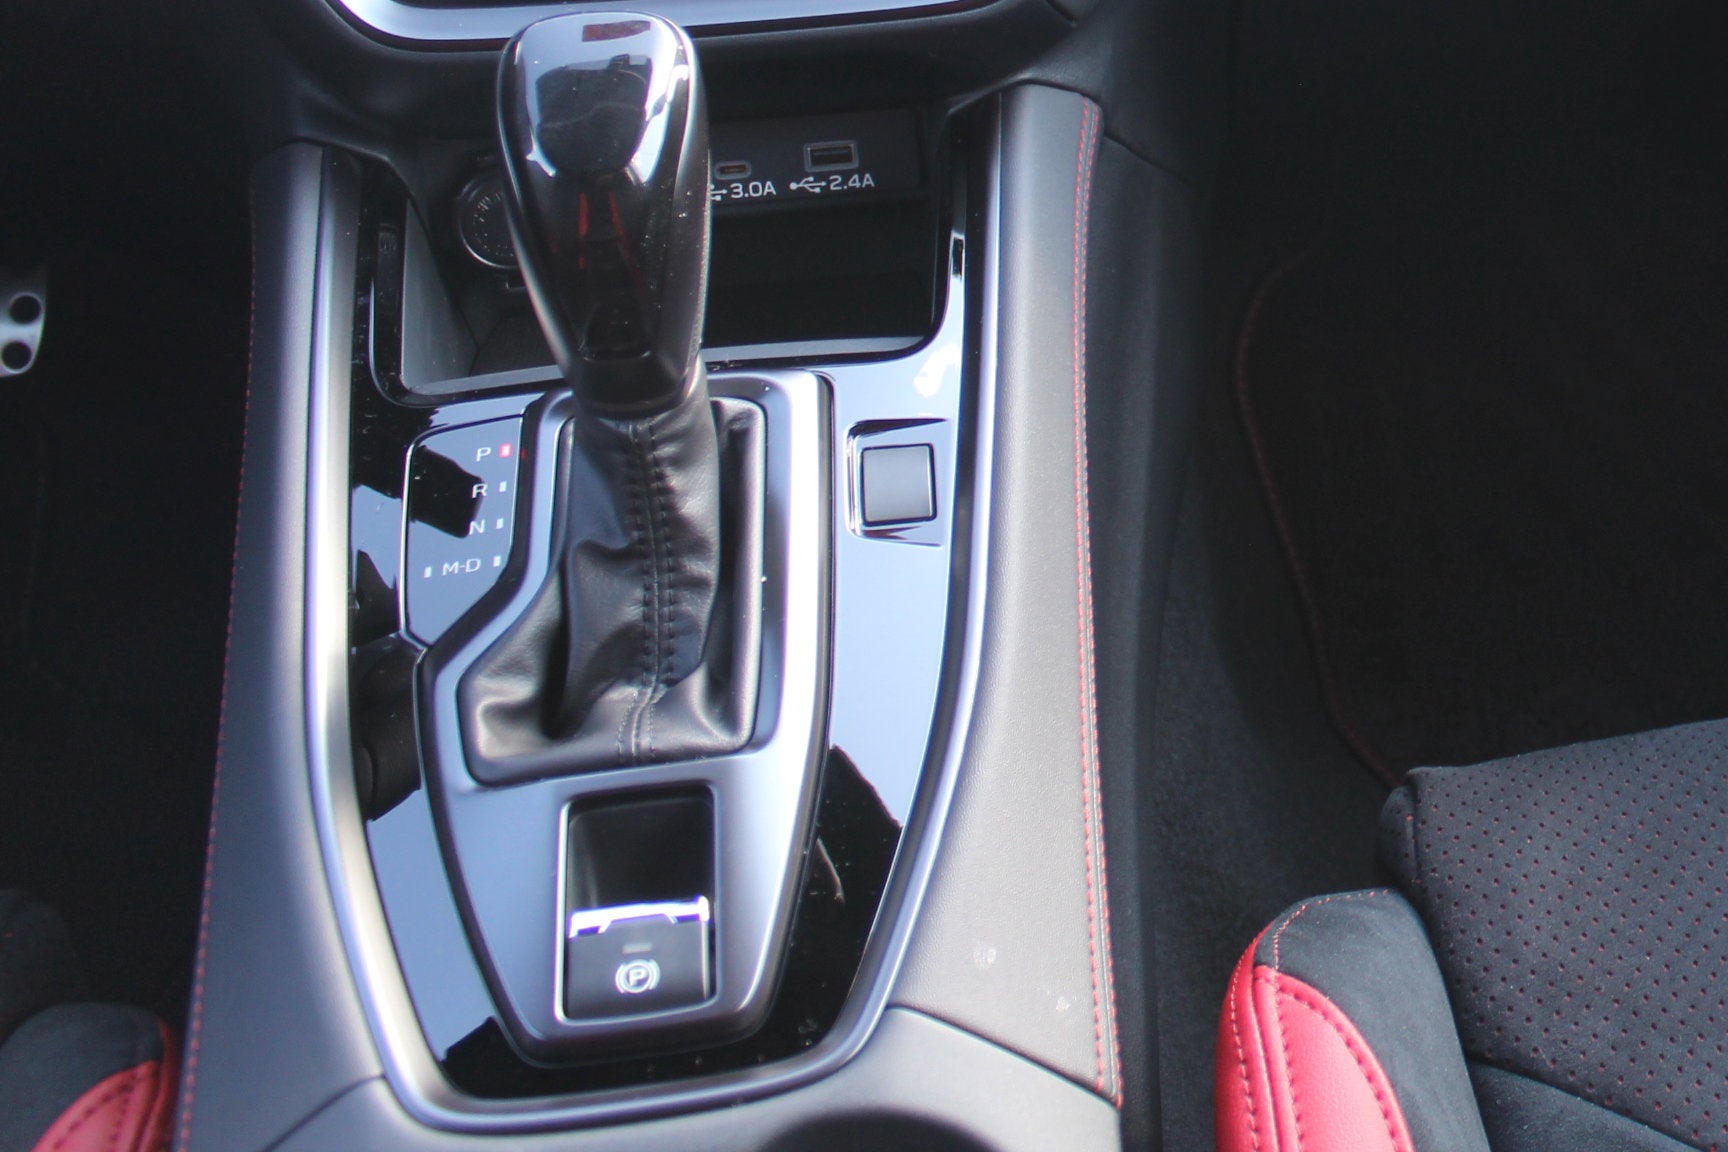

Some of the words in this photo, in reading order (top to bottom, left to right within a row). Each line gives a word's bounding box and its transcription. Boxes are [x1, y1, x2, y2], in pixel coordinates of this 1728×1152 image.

[730, 181, 776, 198] 3.0A
[829, 173, 875, 190] 2.4A
[476, 447, 491, 462] P
[472, 483, 487, 498] R
[469, 519, 485, 535] N
